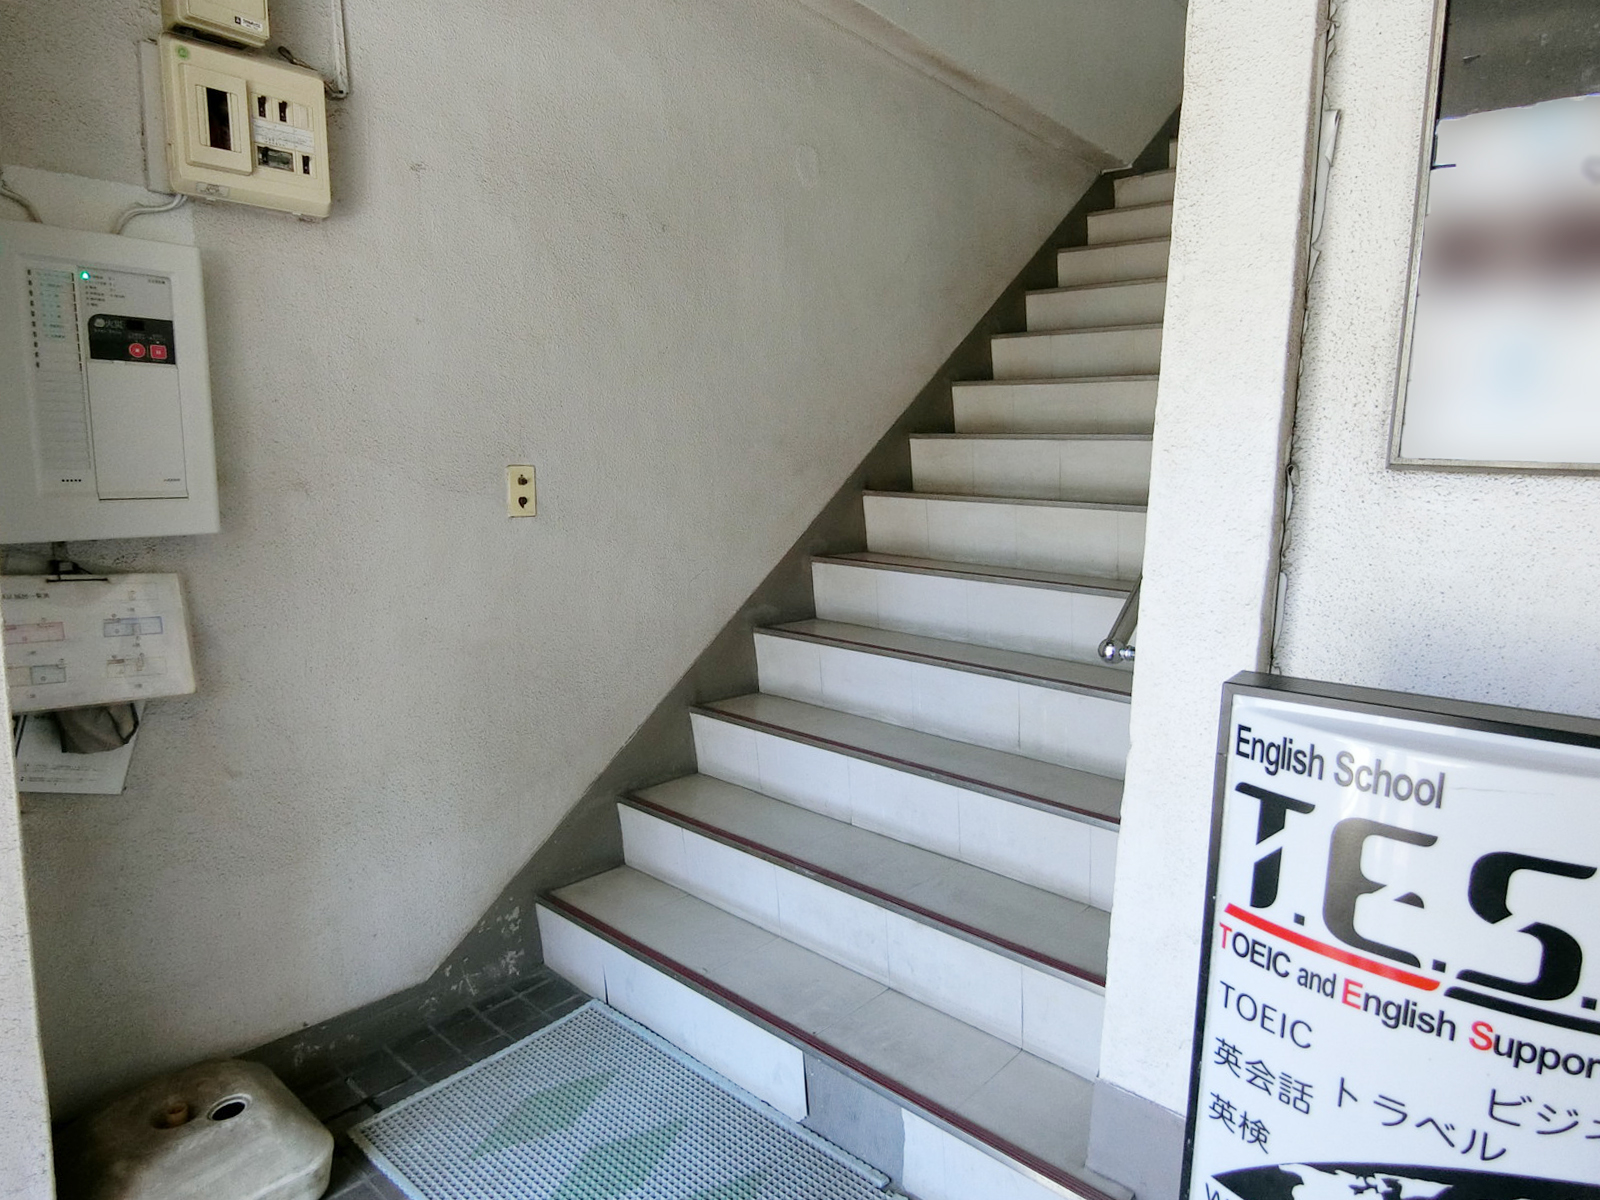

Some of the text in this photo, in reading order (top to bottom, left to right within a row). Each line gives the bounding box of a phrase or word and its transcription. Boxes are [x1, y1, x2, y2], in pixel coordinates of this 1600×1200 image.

[1235, 724, 1445, 808] English School
[1219, 922, 1291, 978] TOEIC
[1297, 965, 1337, 999] and
[1342, 978, 1456, 1041] English
[1219, 981, 1313, 1049] TOEIC
[1208, 1091, 1271, 1154] 英検
[1214, 1037, 1507, 1161] 英会話 トラベル
